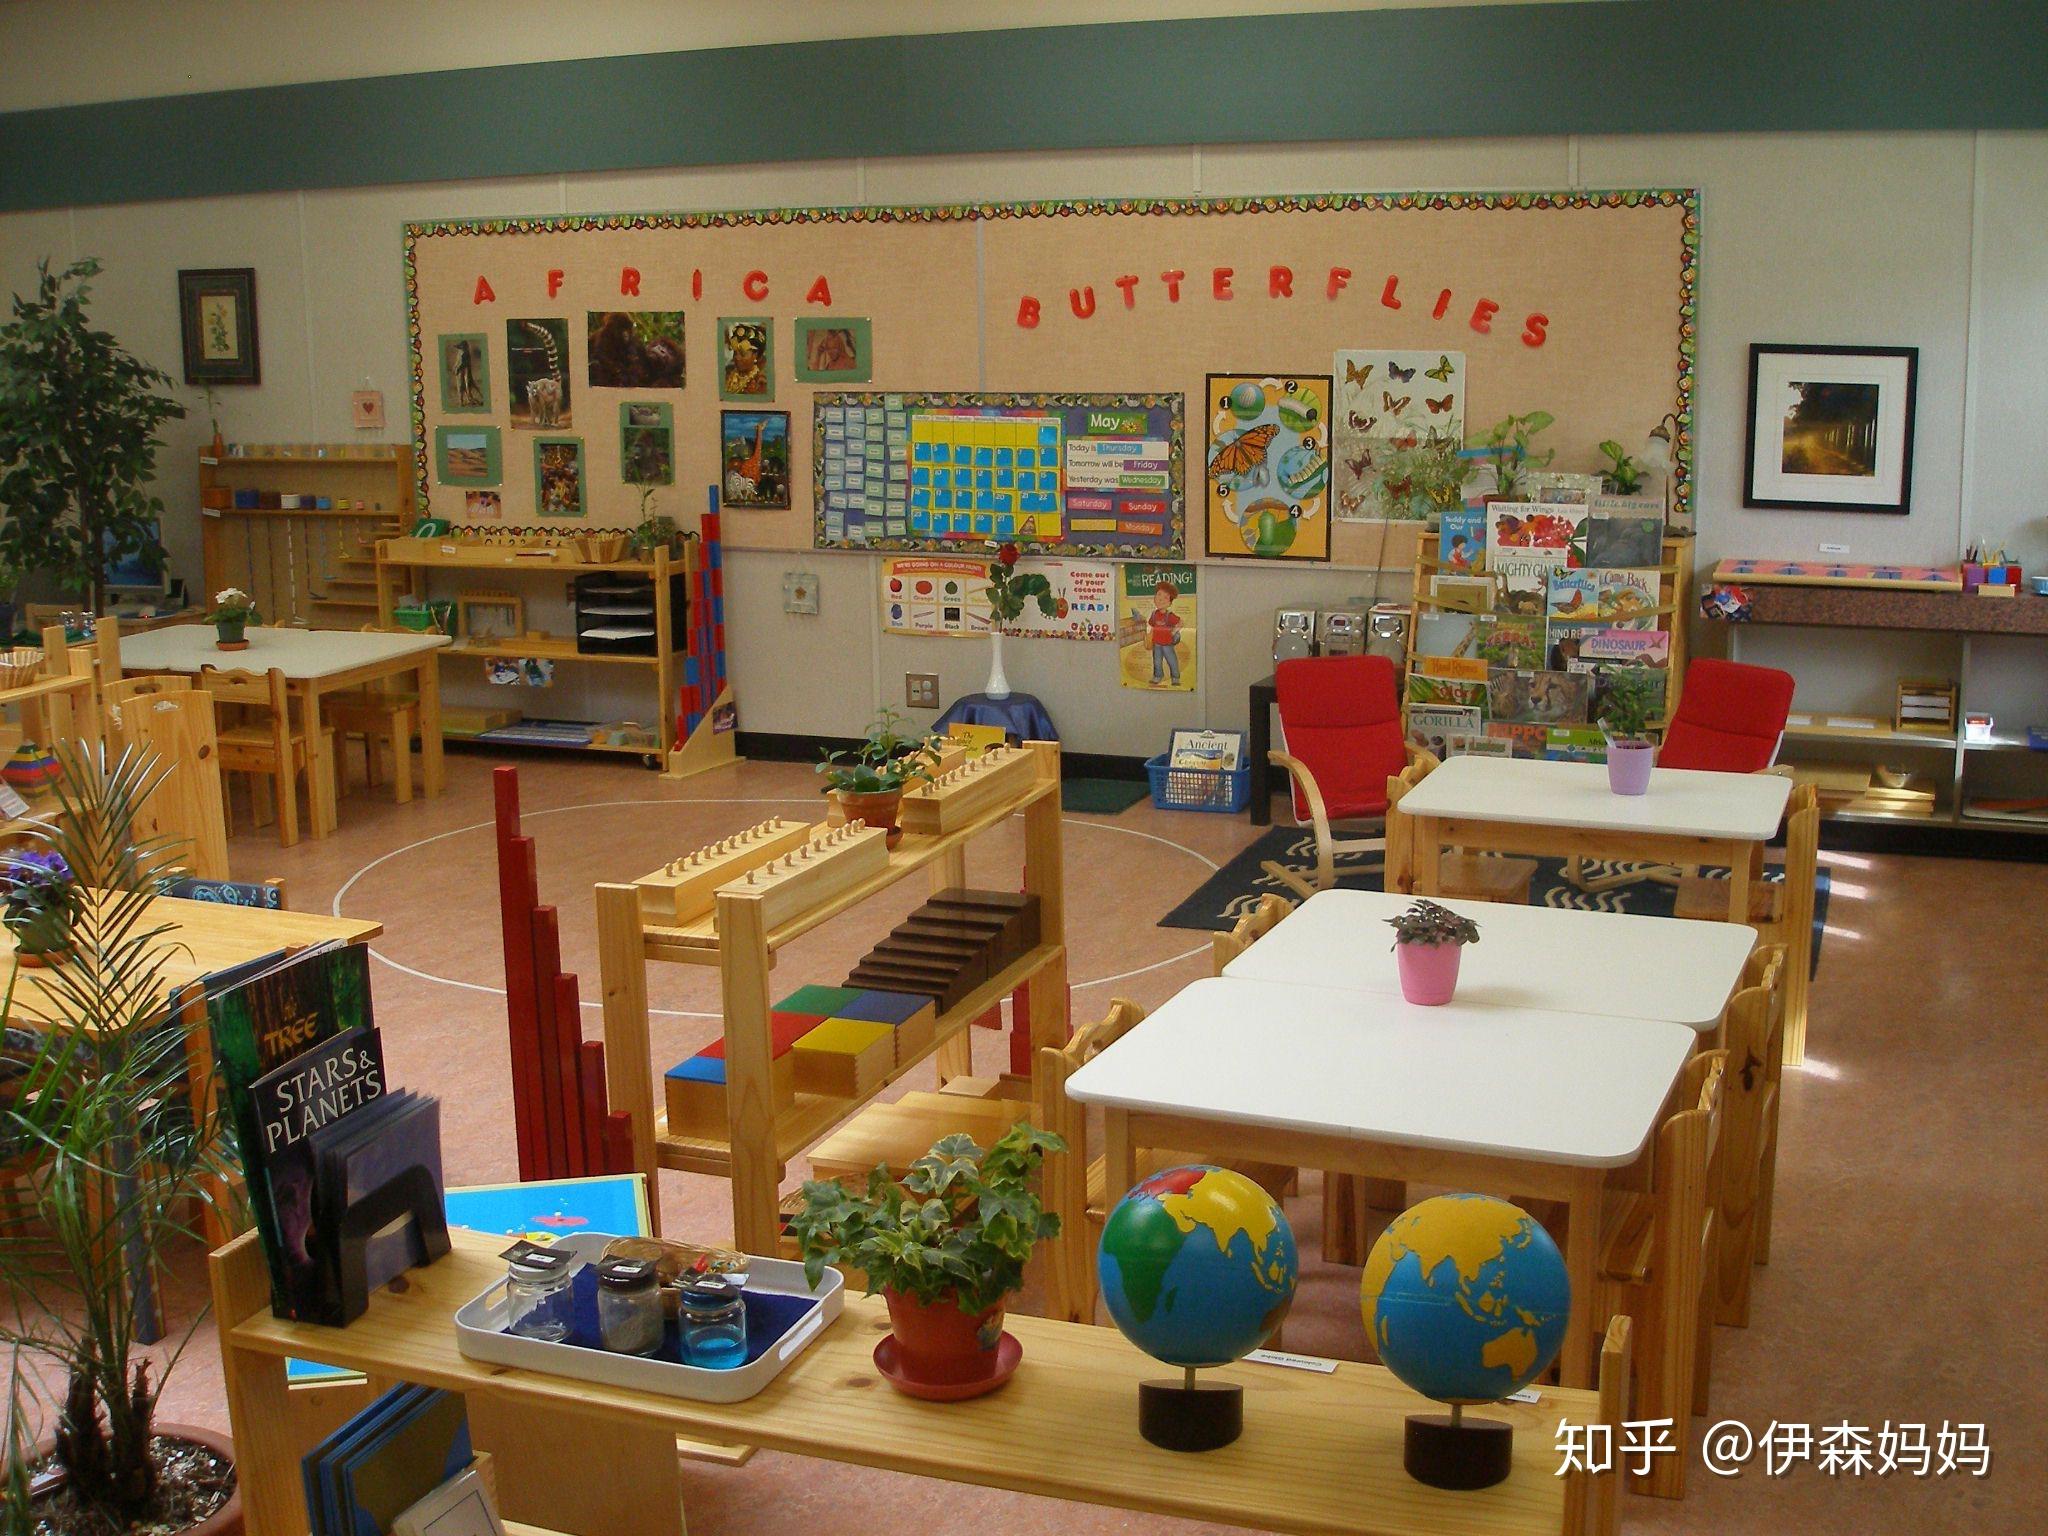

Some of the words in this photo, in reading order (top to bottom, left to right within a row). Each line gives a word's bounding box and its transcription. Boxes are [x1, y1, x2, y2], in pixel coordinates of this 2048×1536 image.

[474, 267, 832, 307] AFRICA
[1017, 265, 1549, 348] BUTTERFLIES
[1288, 382, 1295, 392] 2
[1223, 398, 1229, 408] 1
[1090, 414, 1120, 430] May
[1306, 437, 1313, 448] 3
[1069, 444, 1090, 453] Today
[1102, 444, 1137, 453] Thursday
[1133, 460, 1158, 469] Friday
[1069, 476, 1102, 485] Yesterday
[1121, 476, 1162, 485] Wednesday
[1219, 486, 1227, 496] 5
[1072, 500, 1107, 509] Saturday
[1128, 503, 1157, 512] Sunday
[1491, 505, 1519, 513] Waiting
[1290, 506, 1299, 517] 4
[1445, 516, 1467, 524] Teddy
[1125, 523, 1156, 532] Monday
[1497, 563, 1532, 576] MIGHTY
[1142, 572, 1193, 589] READING!
[1552, 578, 1596, 592] Butterflies
[1071, 603, 1110, 612] READ!
[1550, 629, 1570, 639] HINO
[1591, 638, 1647, 650] DINOSAUR
[1413, 715, 1474, 728] GORILLA
[1187, 739, 1228, 750] Ancient
[264, 1011, 319, 1056] TREE
[276, 1047, 357, 1113] STARS
[266, 1069, 382, 1154] PLANETS
